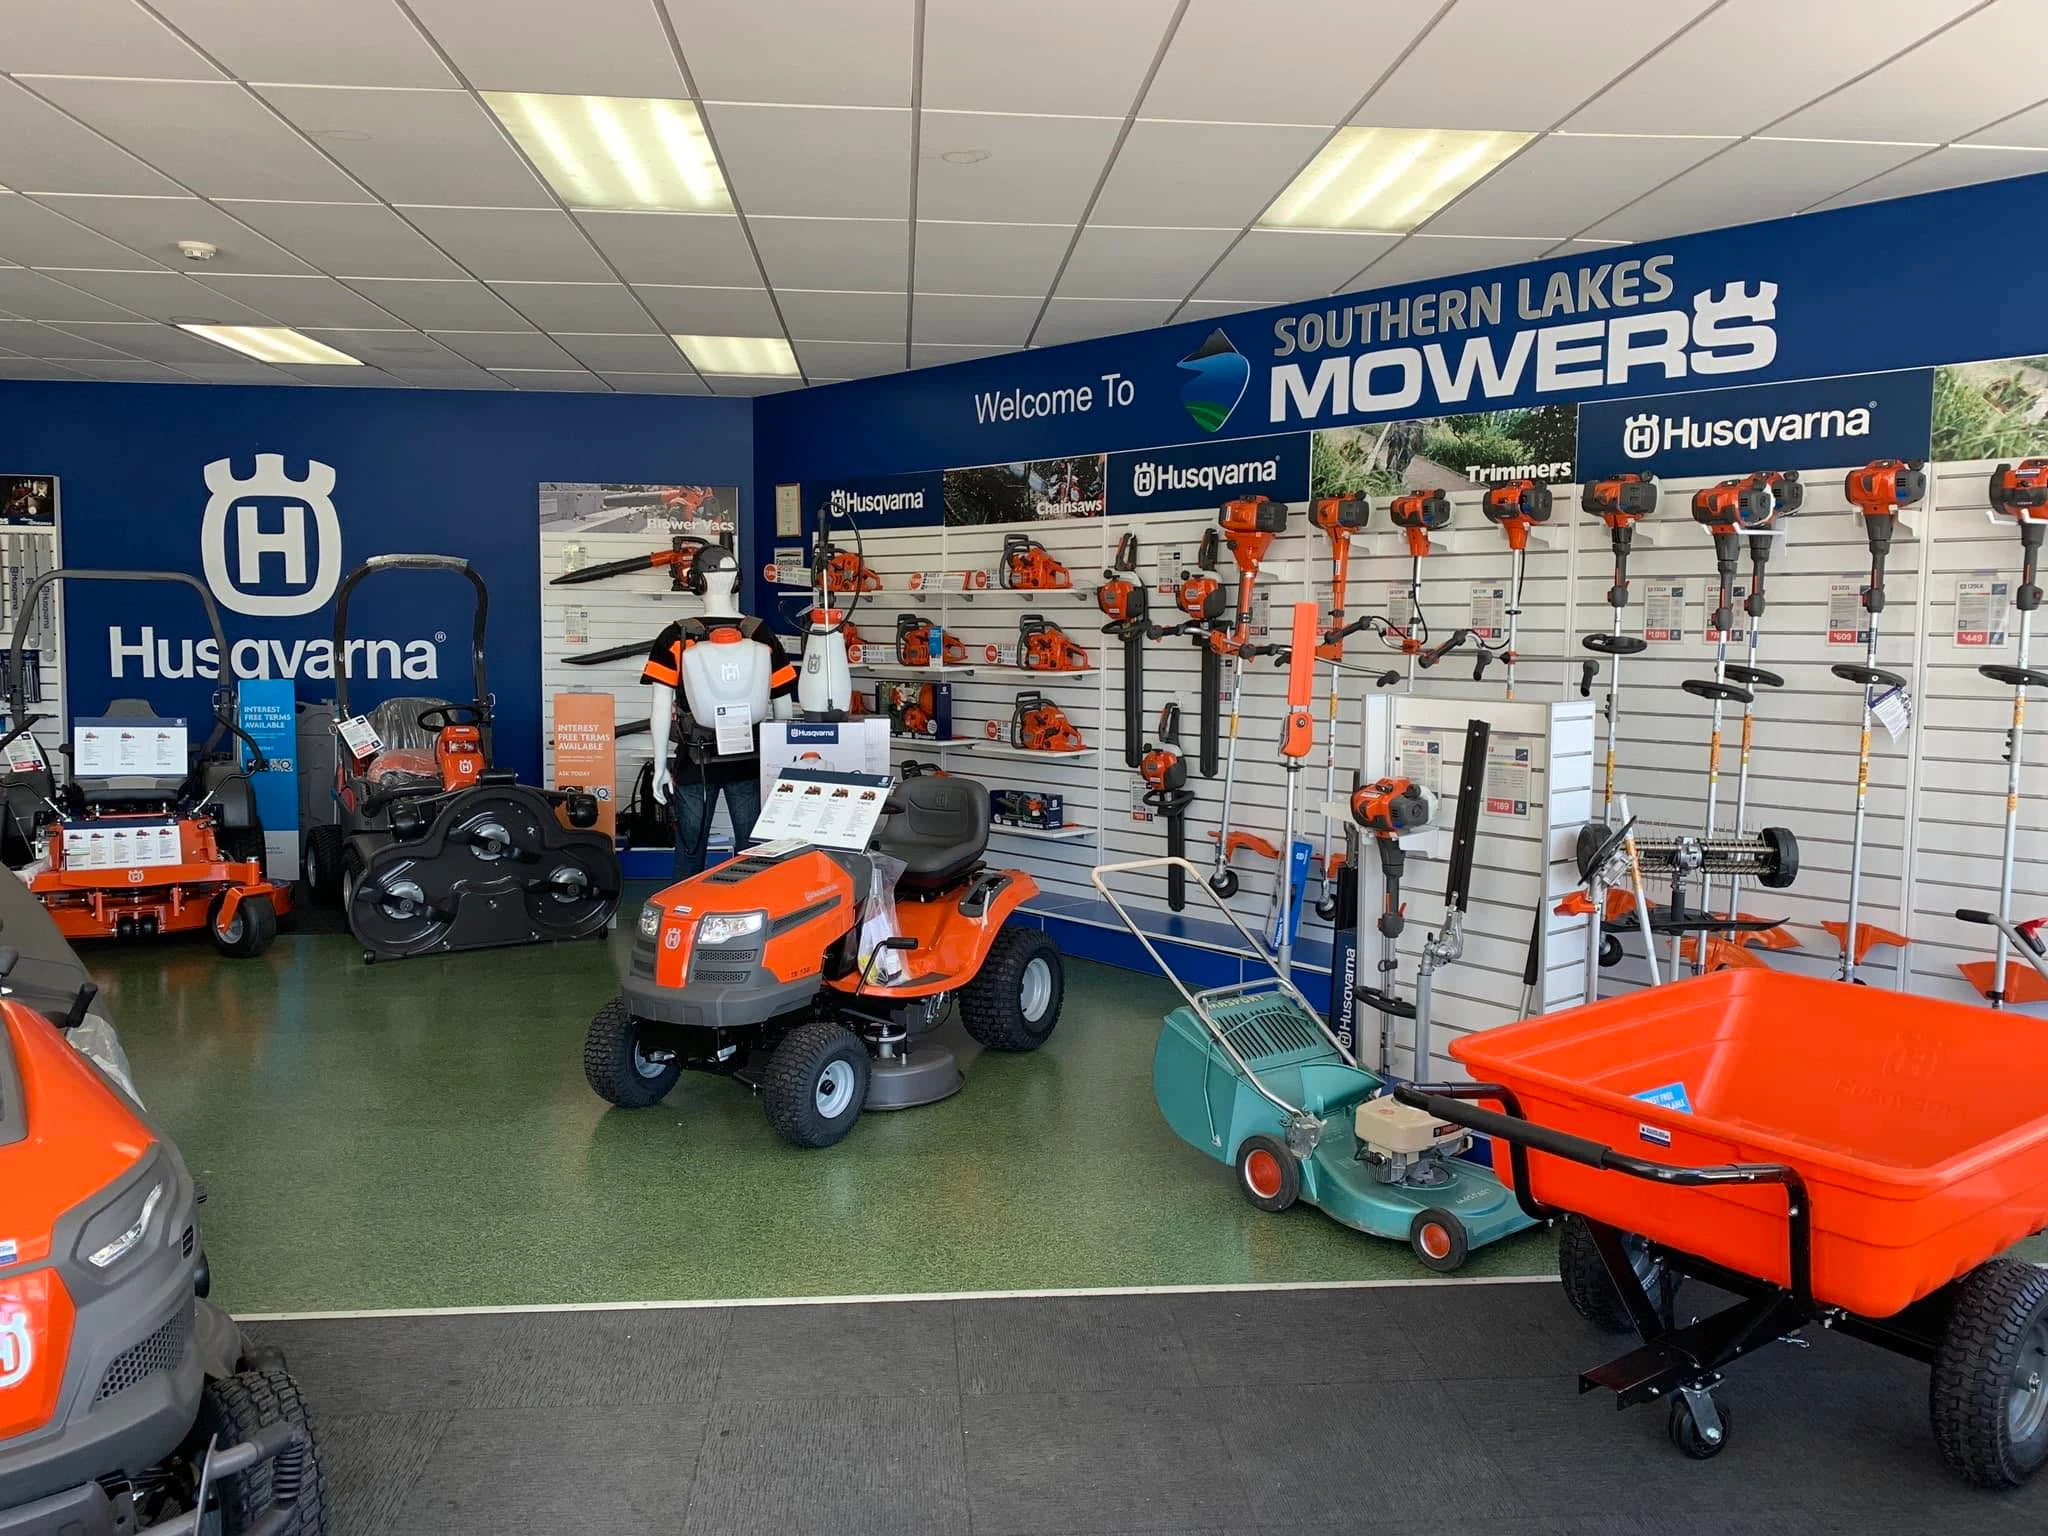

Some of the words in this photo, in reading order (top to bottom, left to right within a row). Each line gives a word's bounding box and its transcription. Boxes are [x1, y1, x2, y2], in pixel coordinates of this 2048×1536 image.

[1274, 282, 1501, 357] SOUTHERN
[1518, 255, 1674, 320] LAKES
[1269, 281, 1778, 422] MOWERS
[975, 385, 1092, 424] Welcome
[1101, 373, 1135, 408] To
[1664, 407, 1871, 450] Husqvarna
[1157, 459, 1277, 492] Husqvarna
[1466, 461, 1571, 482] Trimmers
[846, 491, 924, 515] Husqvarna
[1036, 499, 1103, 517] Chainsaws
[647, 518, 698, 530] Blower
[703, 519, 735, 531] Vacs
[1962, 634, 1983, 643] $449
[109, 626, 438, 680] Husqvarna
[558, 724, 600, 732] INTEREST
[558, 733, 578, 741] FREE
[582, 733, 610, 741] TERMS
[799, 729, 835, 738] Husqvarna
[559, 742, 604, 750] AVAILABLE
[1339, 948, 1356, 1031] Husqvarna
